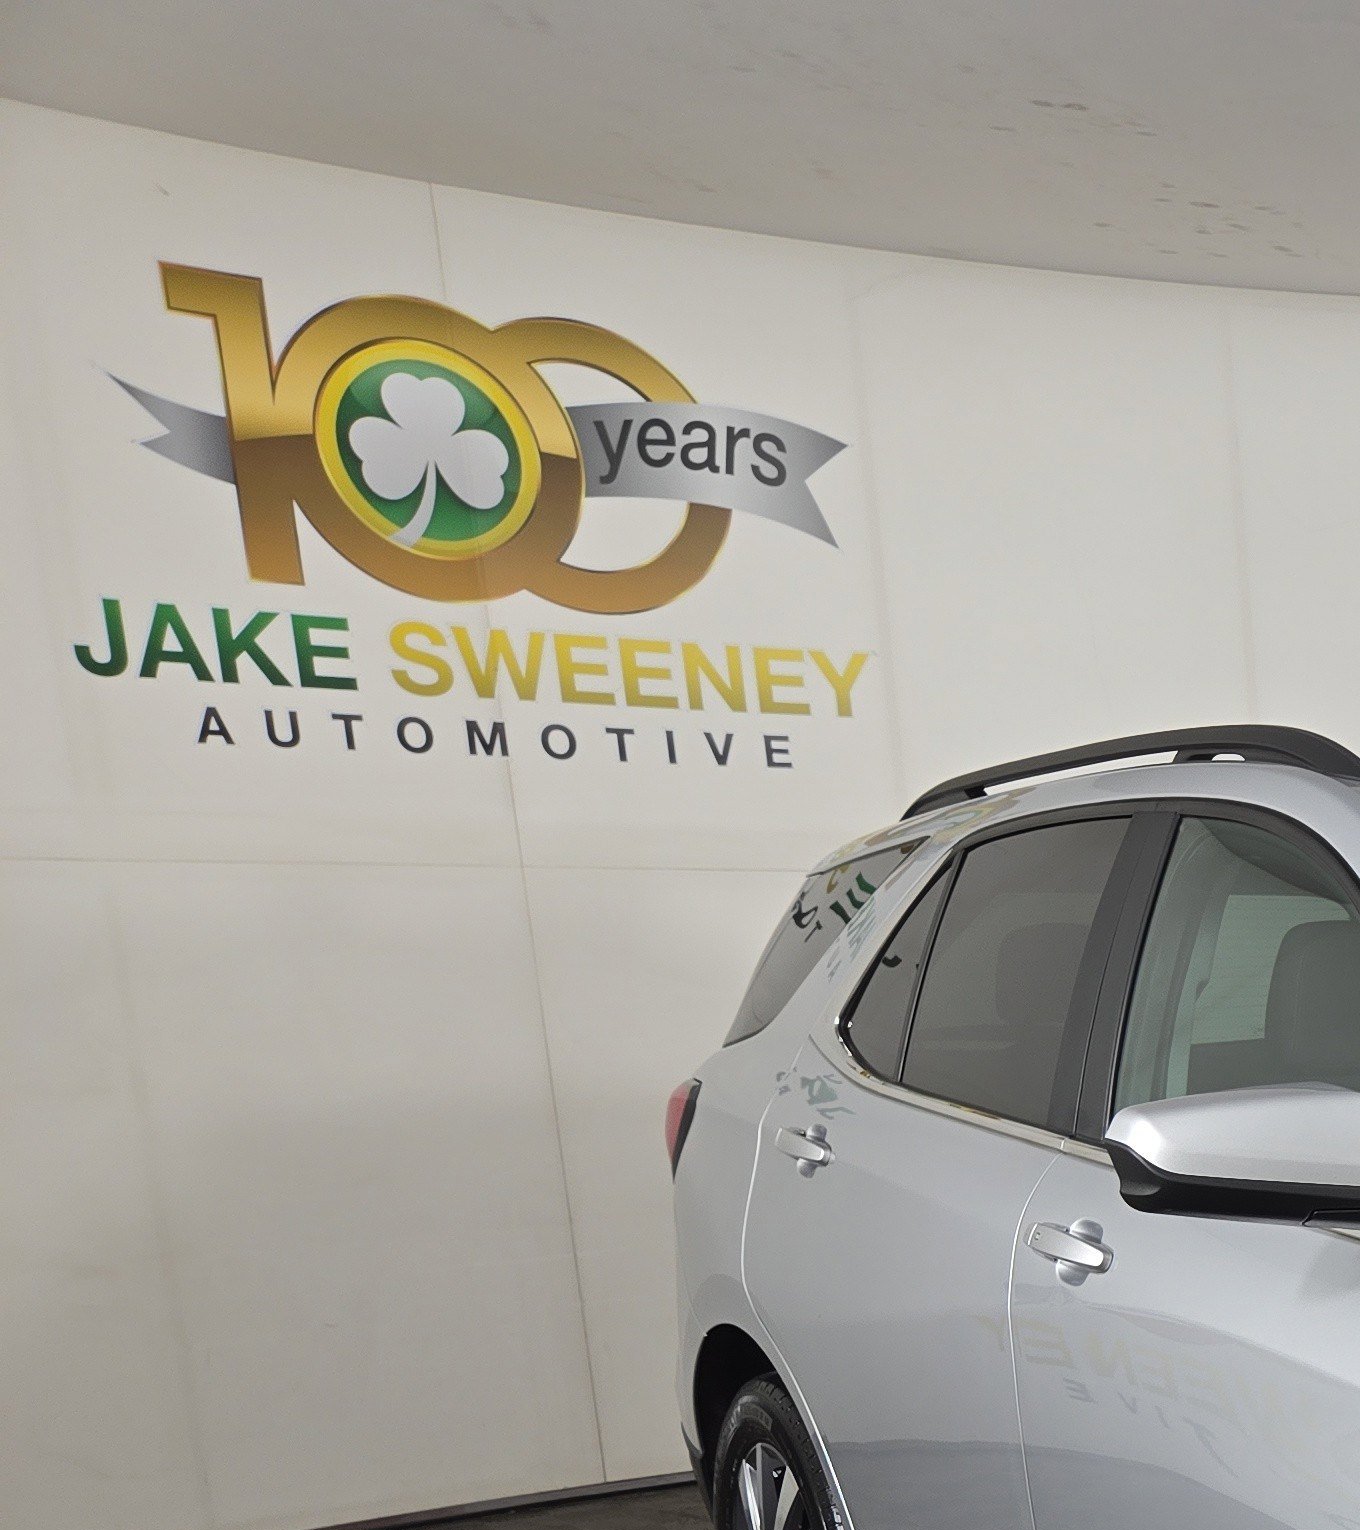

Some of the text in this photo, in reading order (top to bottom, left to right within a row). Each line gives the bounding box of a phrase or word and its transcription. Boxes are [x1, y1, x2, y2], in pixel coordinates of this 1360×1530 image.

[159, 261, 790, 615] 100 years
[74, 599, 868, 718] JAKE SWEENEY
[198, 706, 794, 769] AUTOMOTIVE
